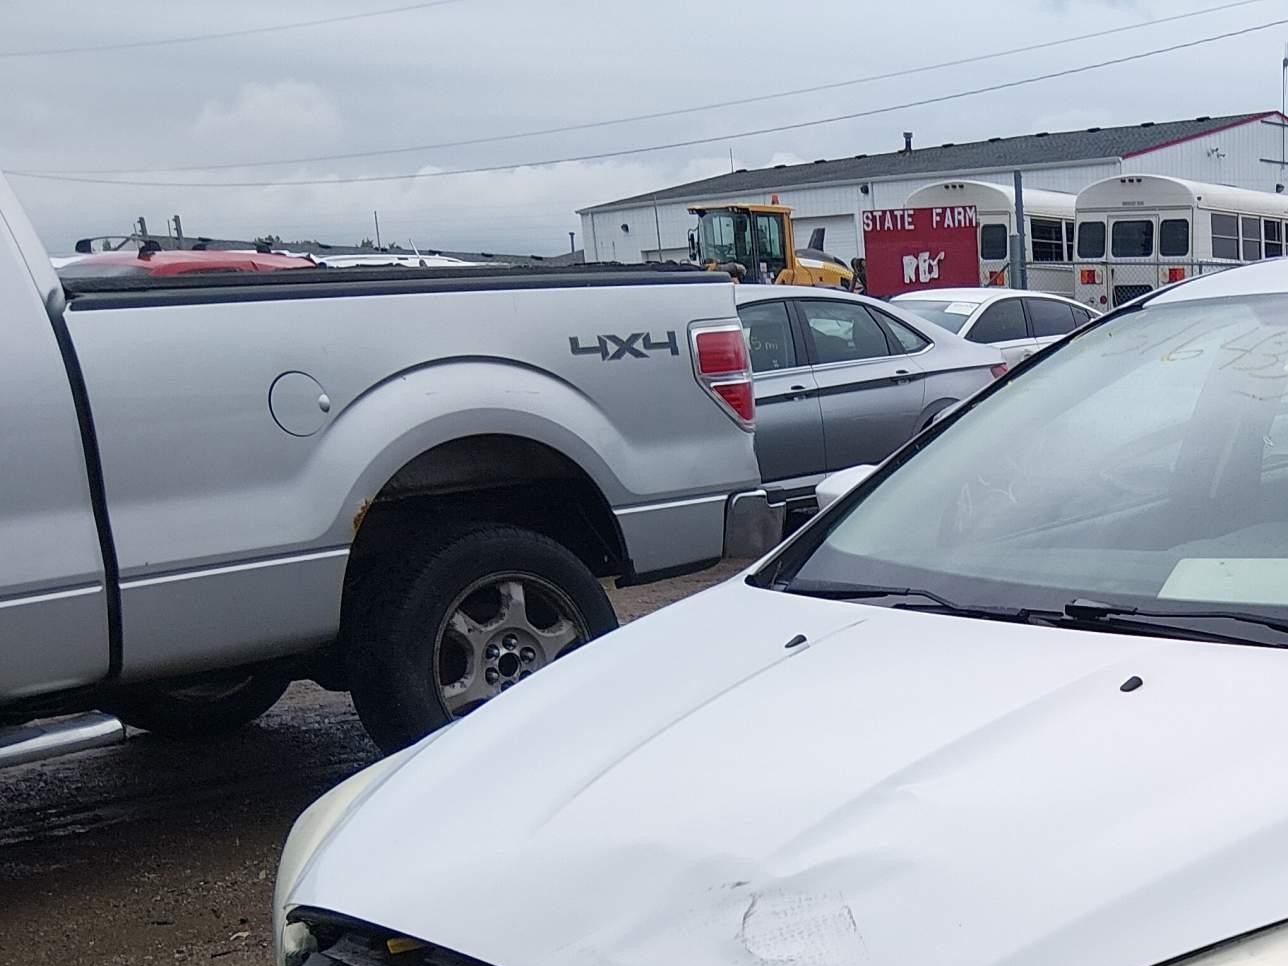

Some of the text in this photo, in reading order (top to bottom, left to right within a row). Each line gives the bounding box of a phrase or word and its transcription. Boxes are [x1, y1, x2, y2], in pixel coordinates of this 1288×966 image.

[863, 206, 976, 231] STATE FARM
[568, 330, 680, 361] 4X4
